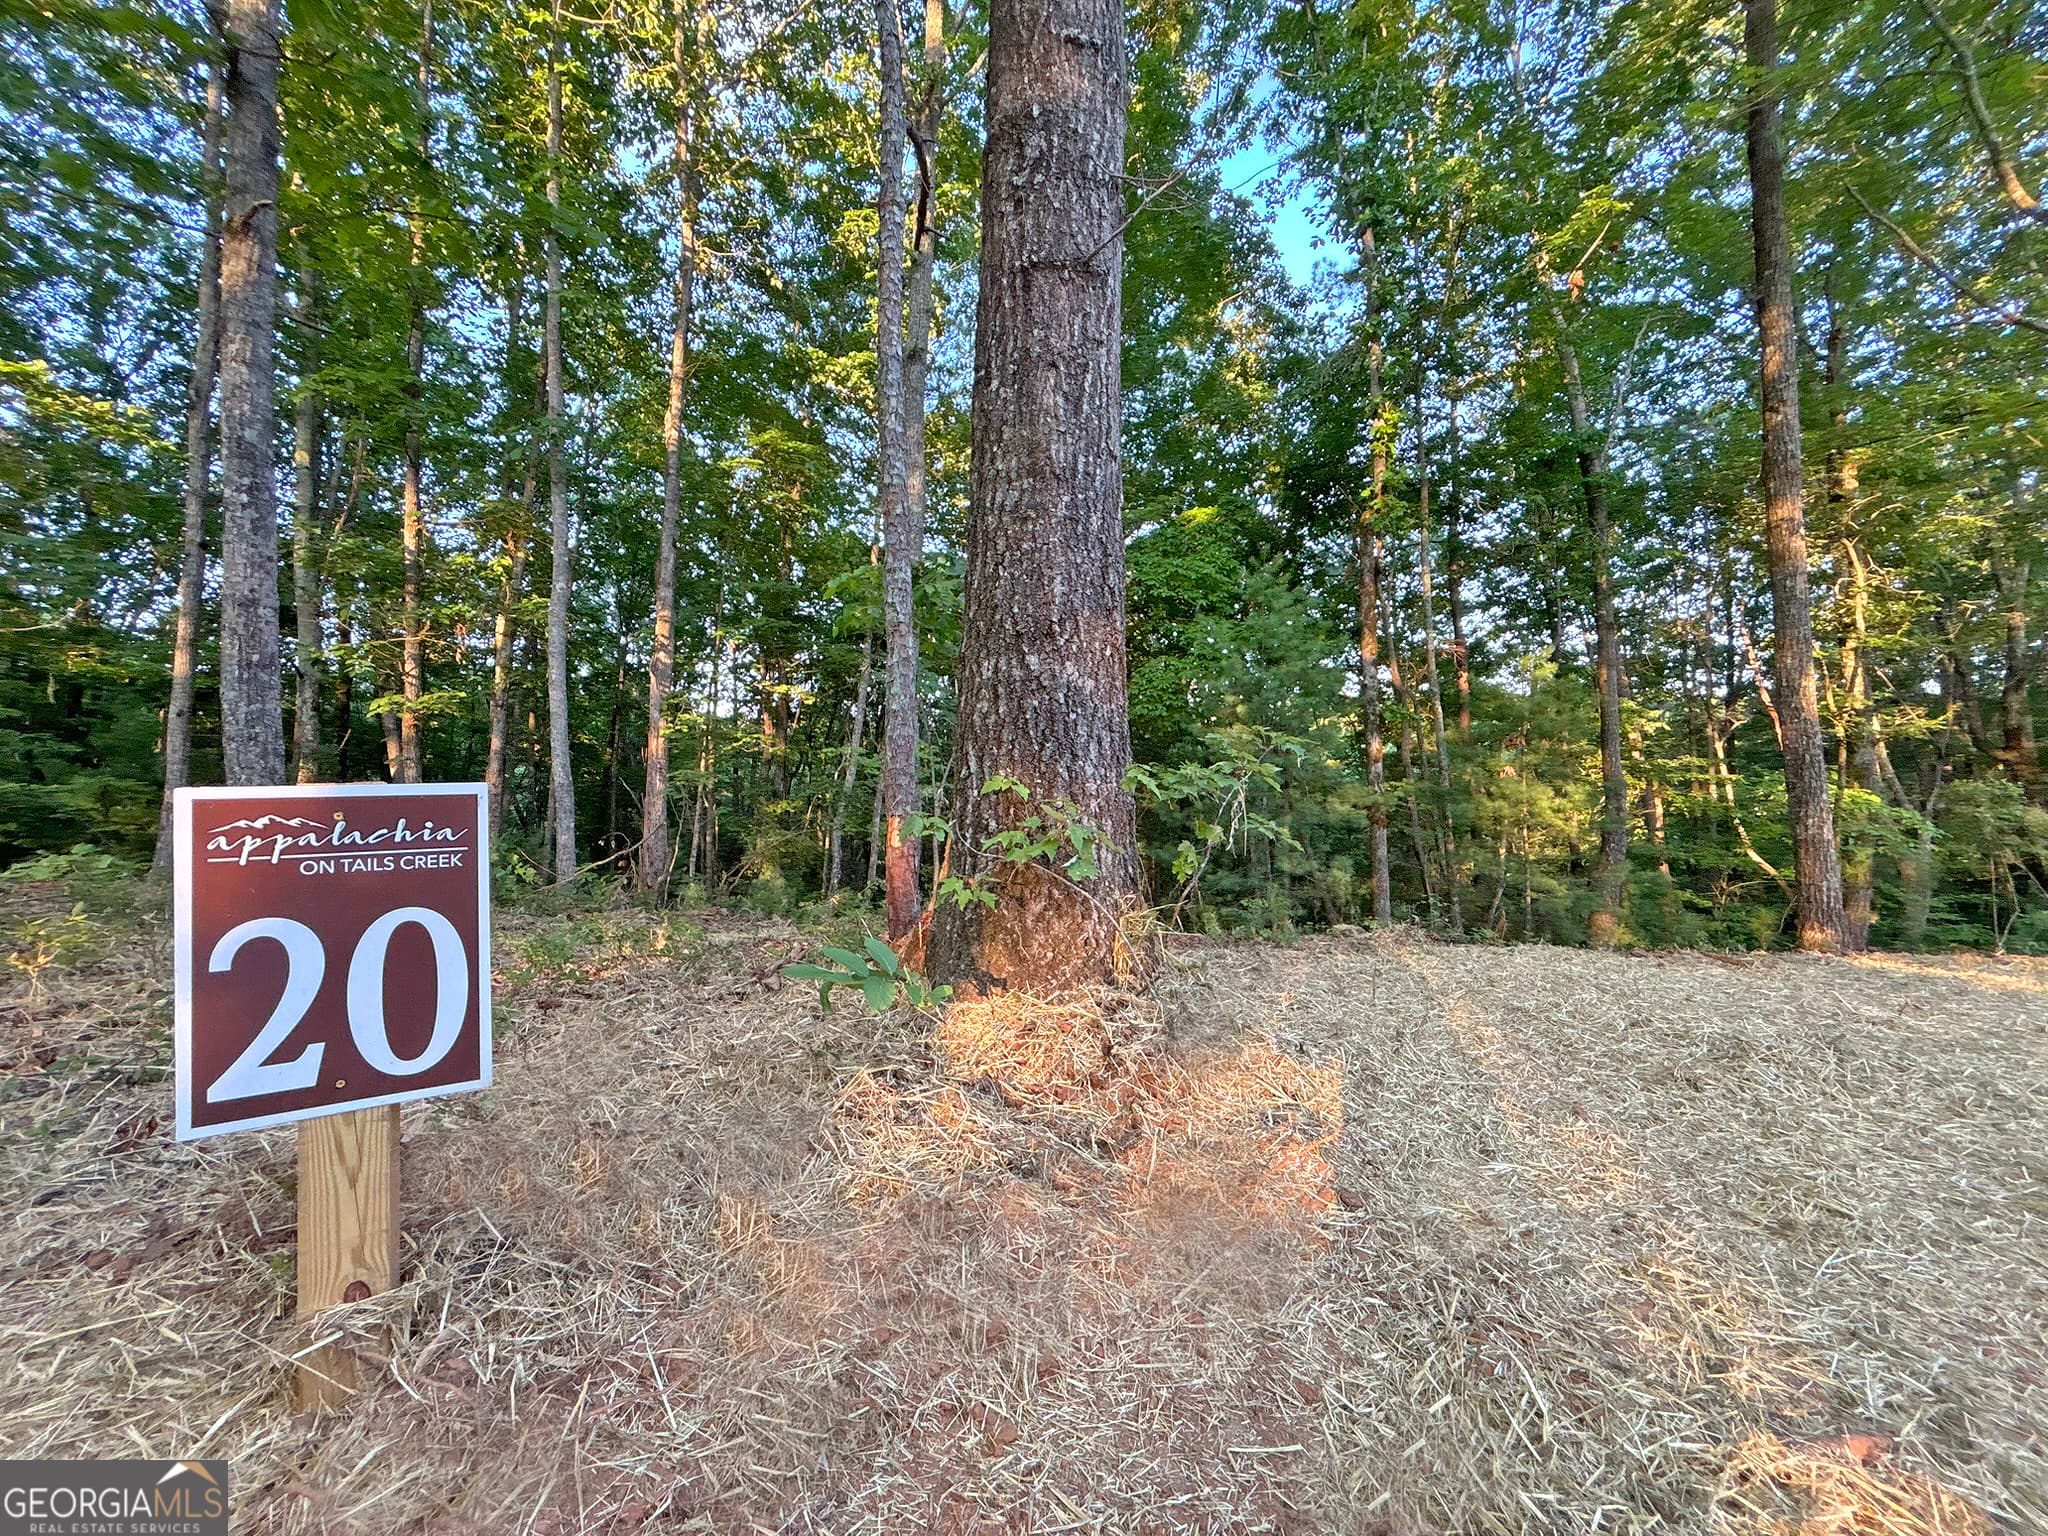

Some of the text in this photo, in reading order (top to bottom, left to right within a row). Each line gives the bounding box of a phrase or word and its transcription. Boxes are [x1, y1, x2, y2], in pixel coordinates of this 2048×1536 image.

[207, 818, 468, 866] appalachia
[299, 853, 464, 876] ON TAILS CREEK
[206, 906, 469, 1104] 20
